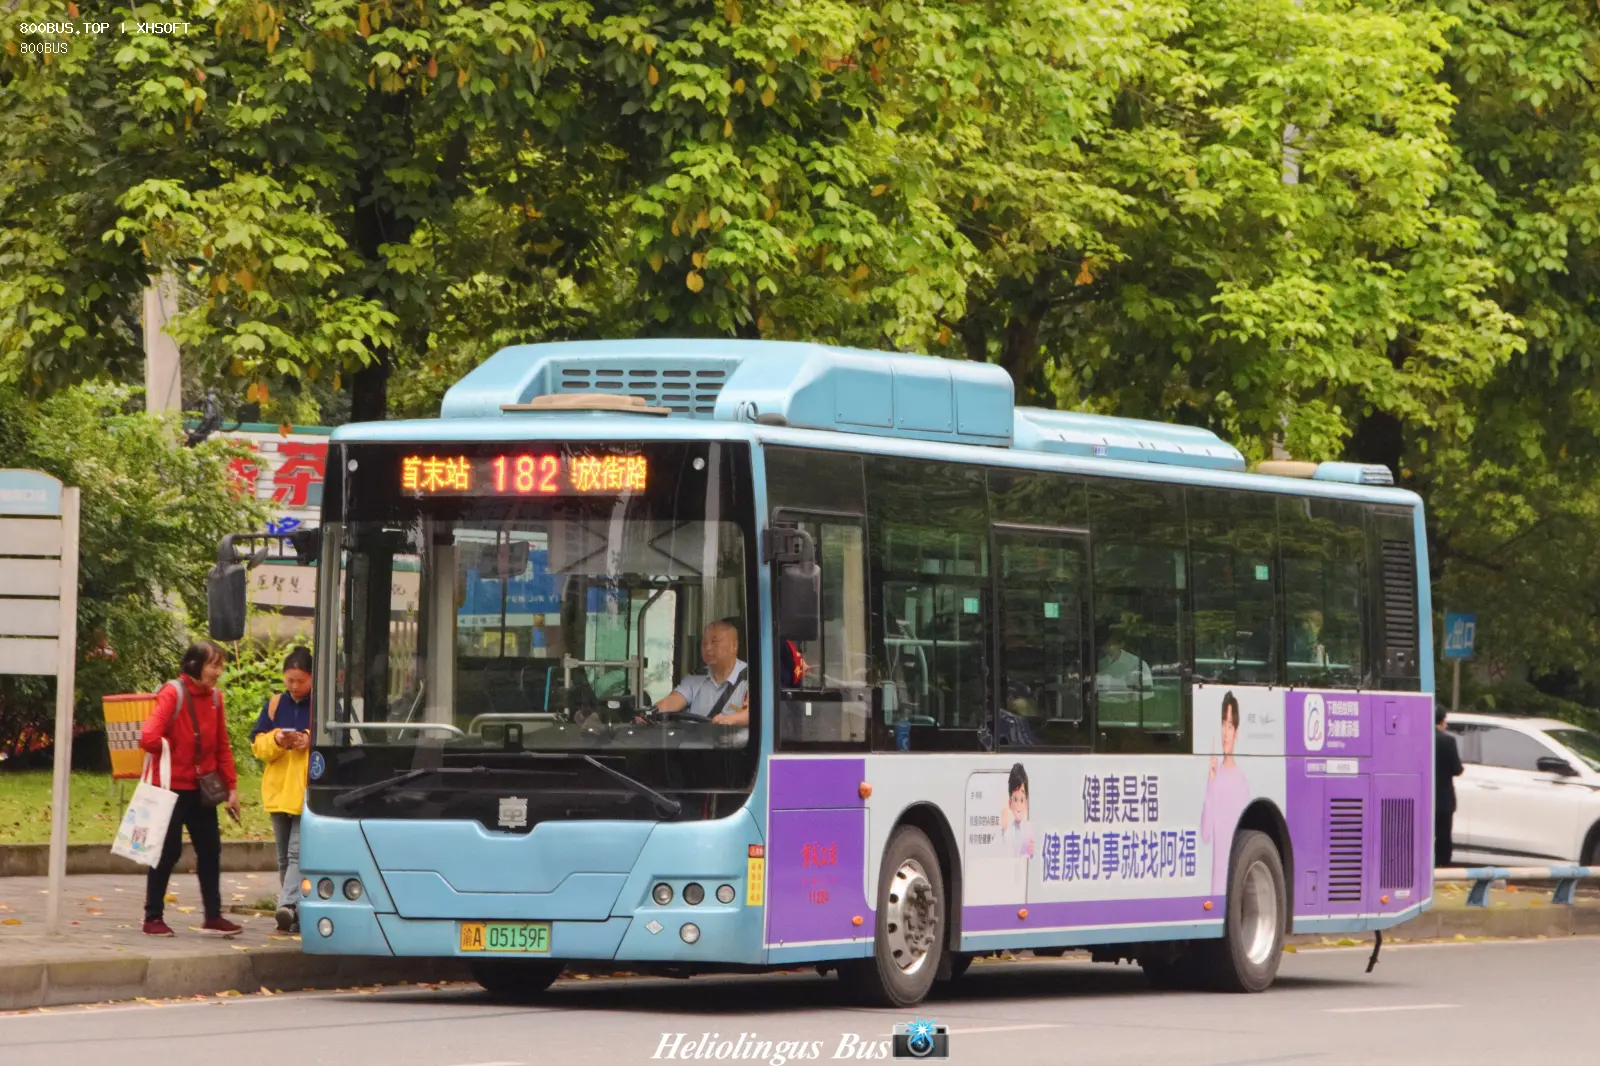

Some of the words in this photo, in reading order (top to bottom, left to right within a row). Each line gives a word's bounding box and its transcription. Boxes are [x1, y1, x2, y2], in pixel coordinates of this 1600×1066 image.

[402, 456, 470, 491] 首末站
[494, 456, 558, 492] 182
[571, 456, 647, 491] 放街路
[1082, 773, 1159, 824] 健康是福
[1041, 829, 1197, 882] 健康的事就找阿福
